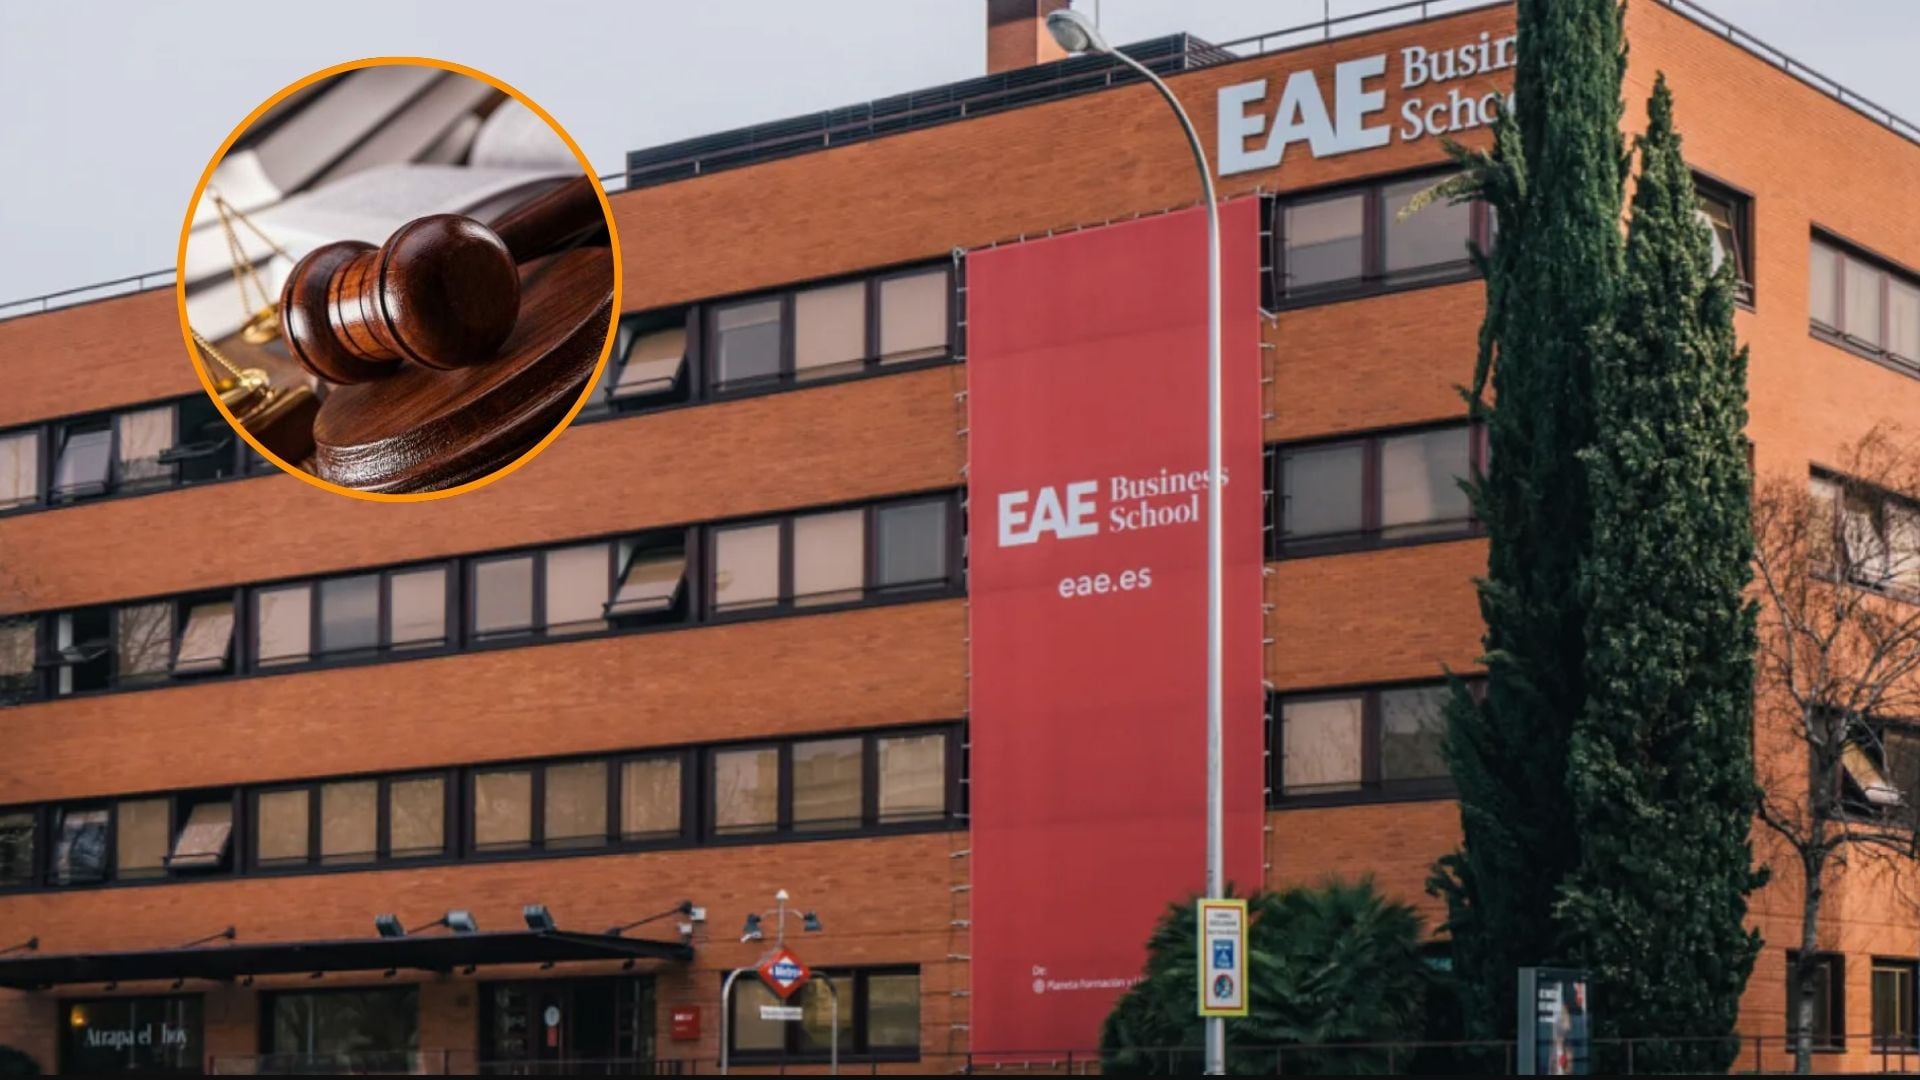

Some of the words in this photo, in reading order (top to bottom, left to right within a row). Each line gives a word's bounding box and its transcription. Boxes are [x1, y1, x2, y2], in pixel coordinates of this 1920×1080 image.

[1400, 31, 1518, 89] Busin
[1217, 54, 1392, 177] EAE
[1400, 88, 1516, 142] Scho
[997, 480, 1099, 548] EAE
[1109, 494, 1200, 533] School
[1058, 567, 1153, 598] eae.es
[84, 1027, 135, 1051] Atrapa
[138, 1023, 152, 1045] el
[161, 1023, 187, 1050] hoy
